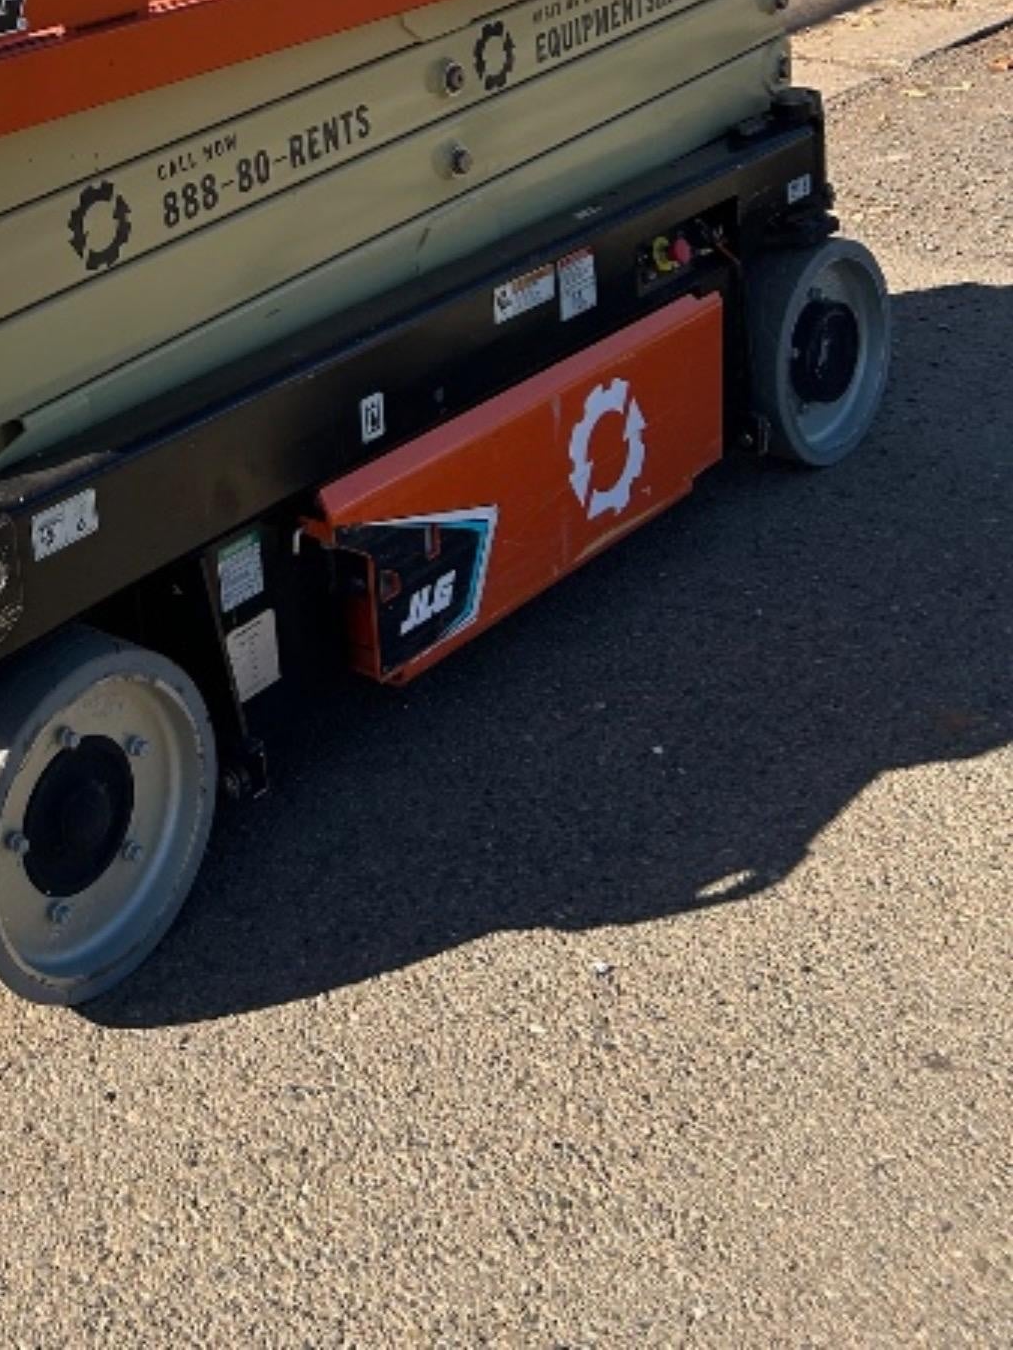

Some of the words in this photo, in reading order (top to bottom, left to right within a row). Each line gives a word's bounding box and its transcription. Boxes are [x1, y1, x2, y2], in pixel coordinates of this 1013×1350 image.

[157, 152, 196, 181] CALL
[203, 134, 238, 161] NOW
[162, 104, 370, 228] 888-80-RENTS
[400, 569, 456, 635] JLG
